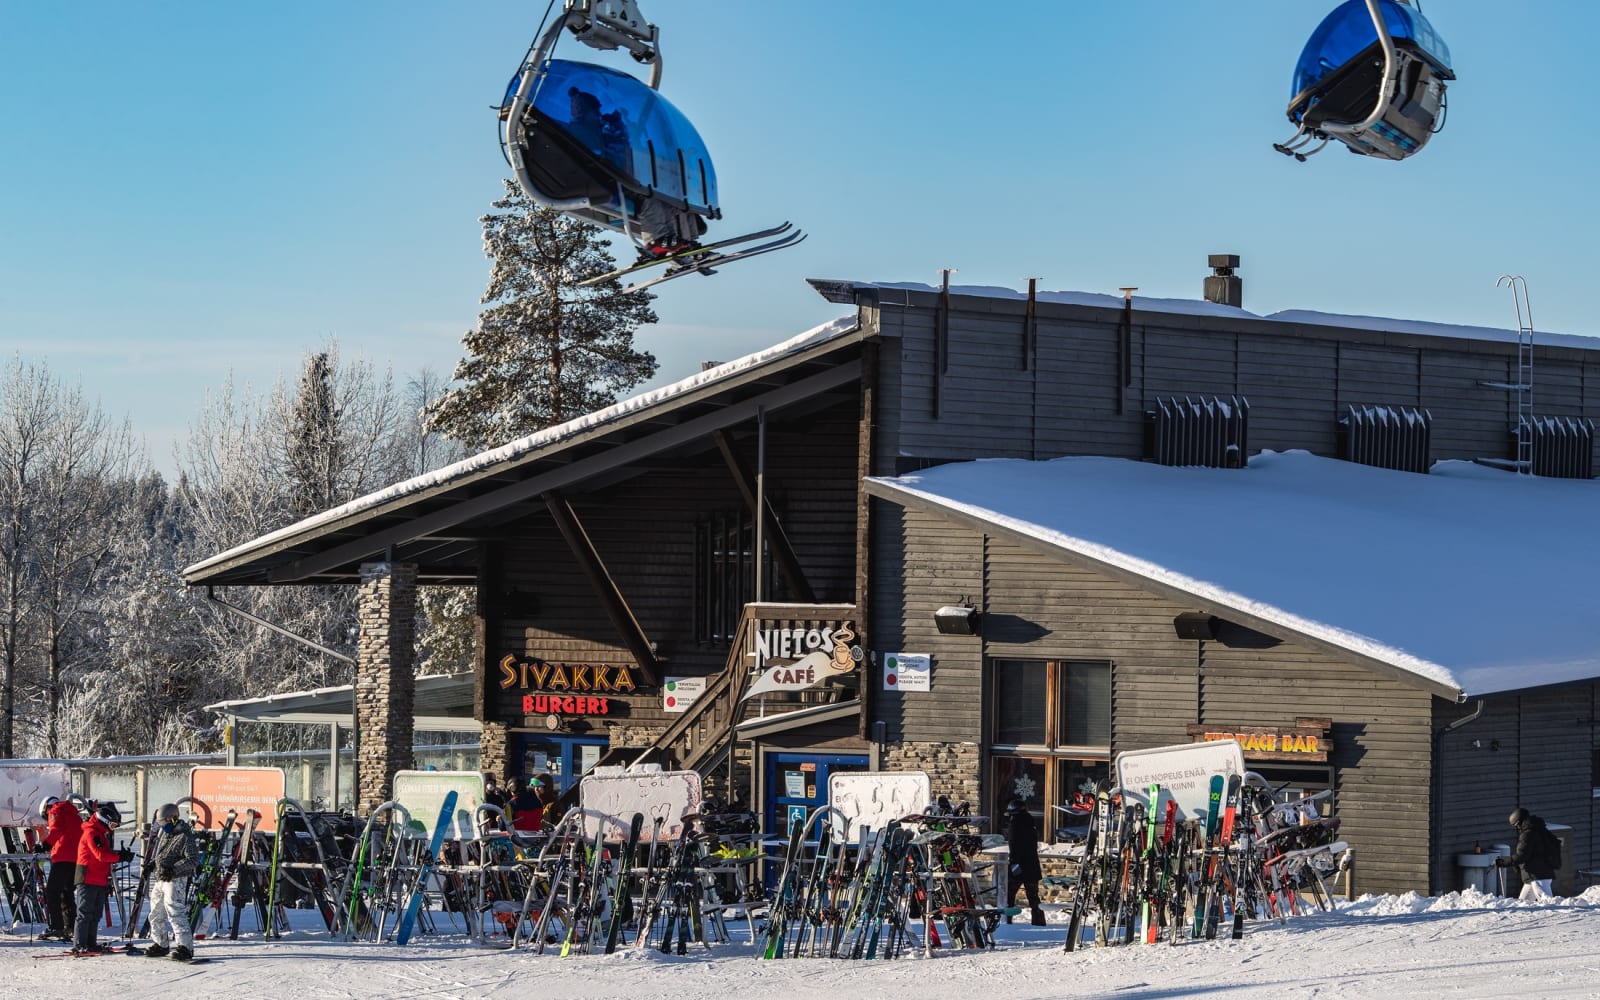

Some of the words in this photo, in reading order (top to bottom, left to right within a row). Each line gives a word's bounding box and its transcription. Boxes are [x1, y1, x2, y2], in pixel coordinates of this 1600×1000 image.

[755, 626, 834, 671] NIETOS
[499, 653, 636, 692] SIVAKKA
[773, 664, 815, 684] CAFÉ
[522, 694, 609, 714] BURGERS
[1282, 735, 1318, 752] BAR
[1126, 777, 1133, 785] EI
[1134, 774, 1150, 784] OLE
[1151, 771, 1183, 782] NOPEUS
[1184, 767, 1207, 777] ENÄÄ
[1171, 782, 1195, 790] KIINNI
